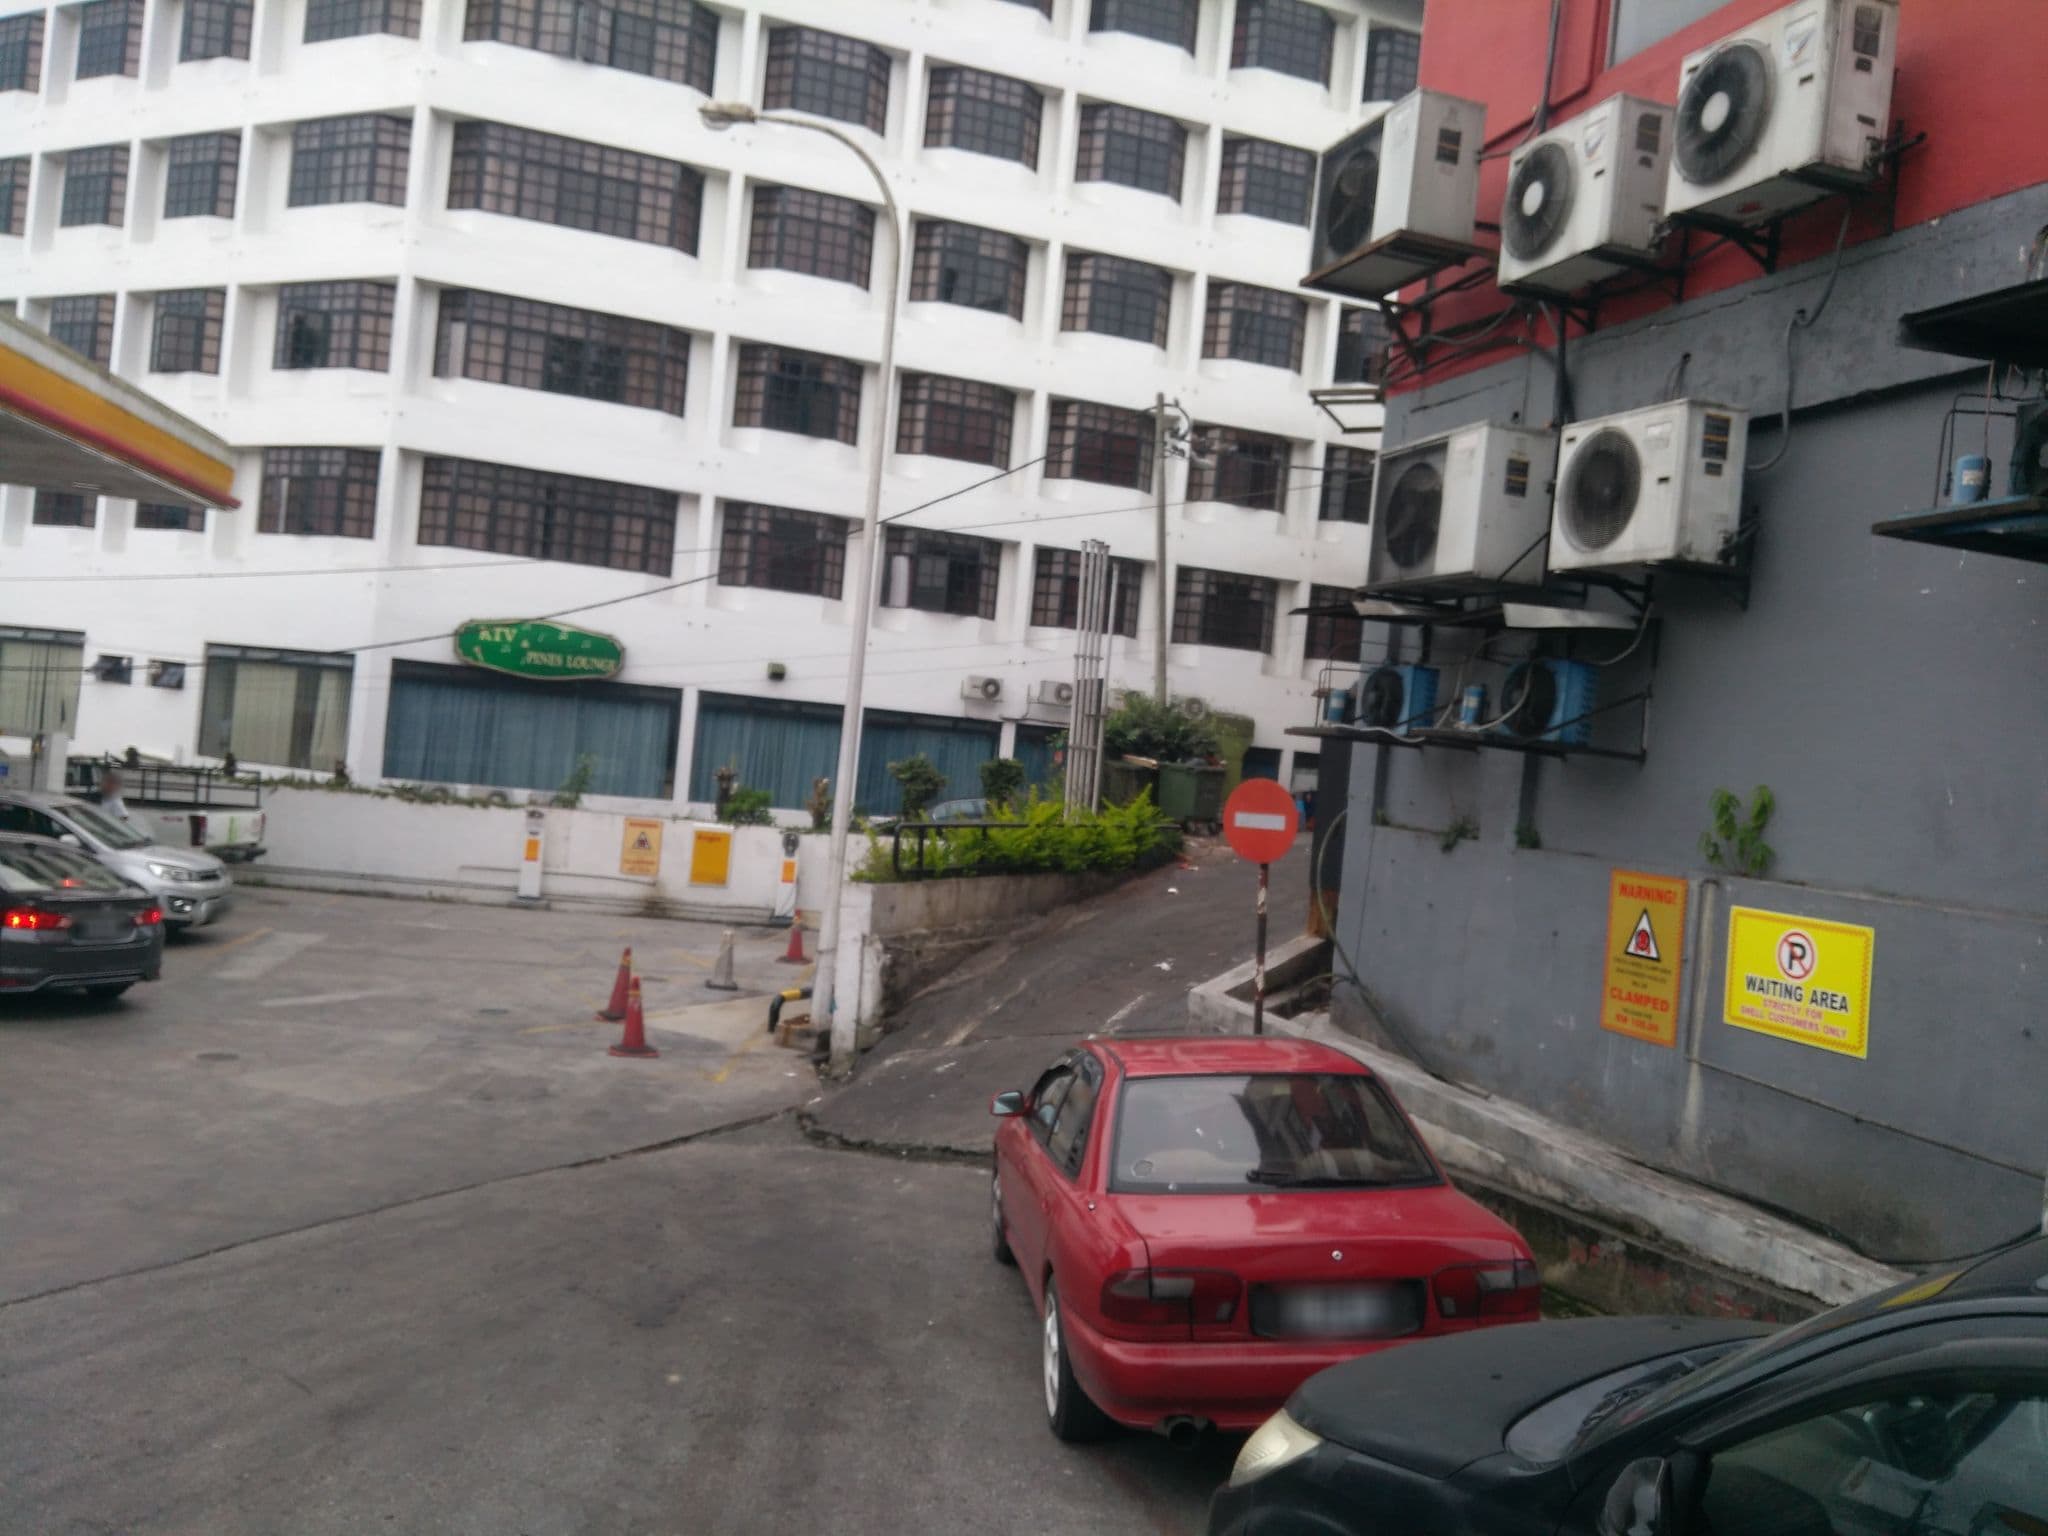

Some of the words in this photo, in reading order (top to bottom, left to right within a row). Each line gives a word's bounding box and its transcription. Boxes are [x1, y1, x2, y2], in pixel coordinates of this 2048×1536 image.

[1610, 987, 1670, 1013] CLAMPED
[1746, 974, 1804, 1002] WAITING
[1809, 989, 1849, 1013] AREA
[1805, 1008, 1823, 1020] FOR
[1822, 1024, 1848, 1039] ONLY
